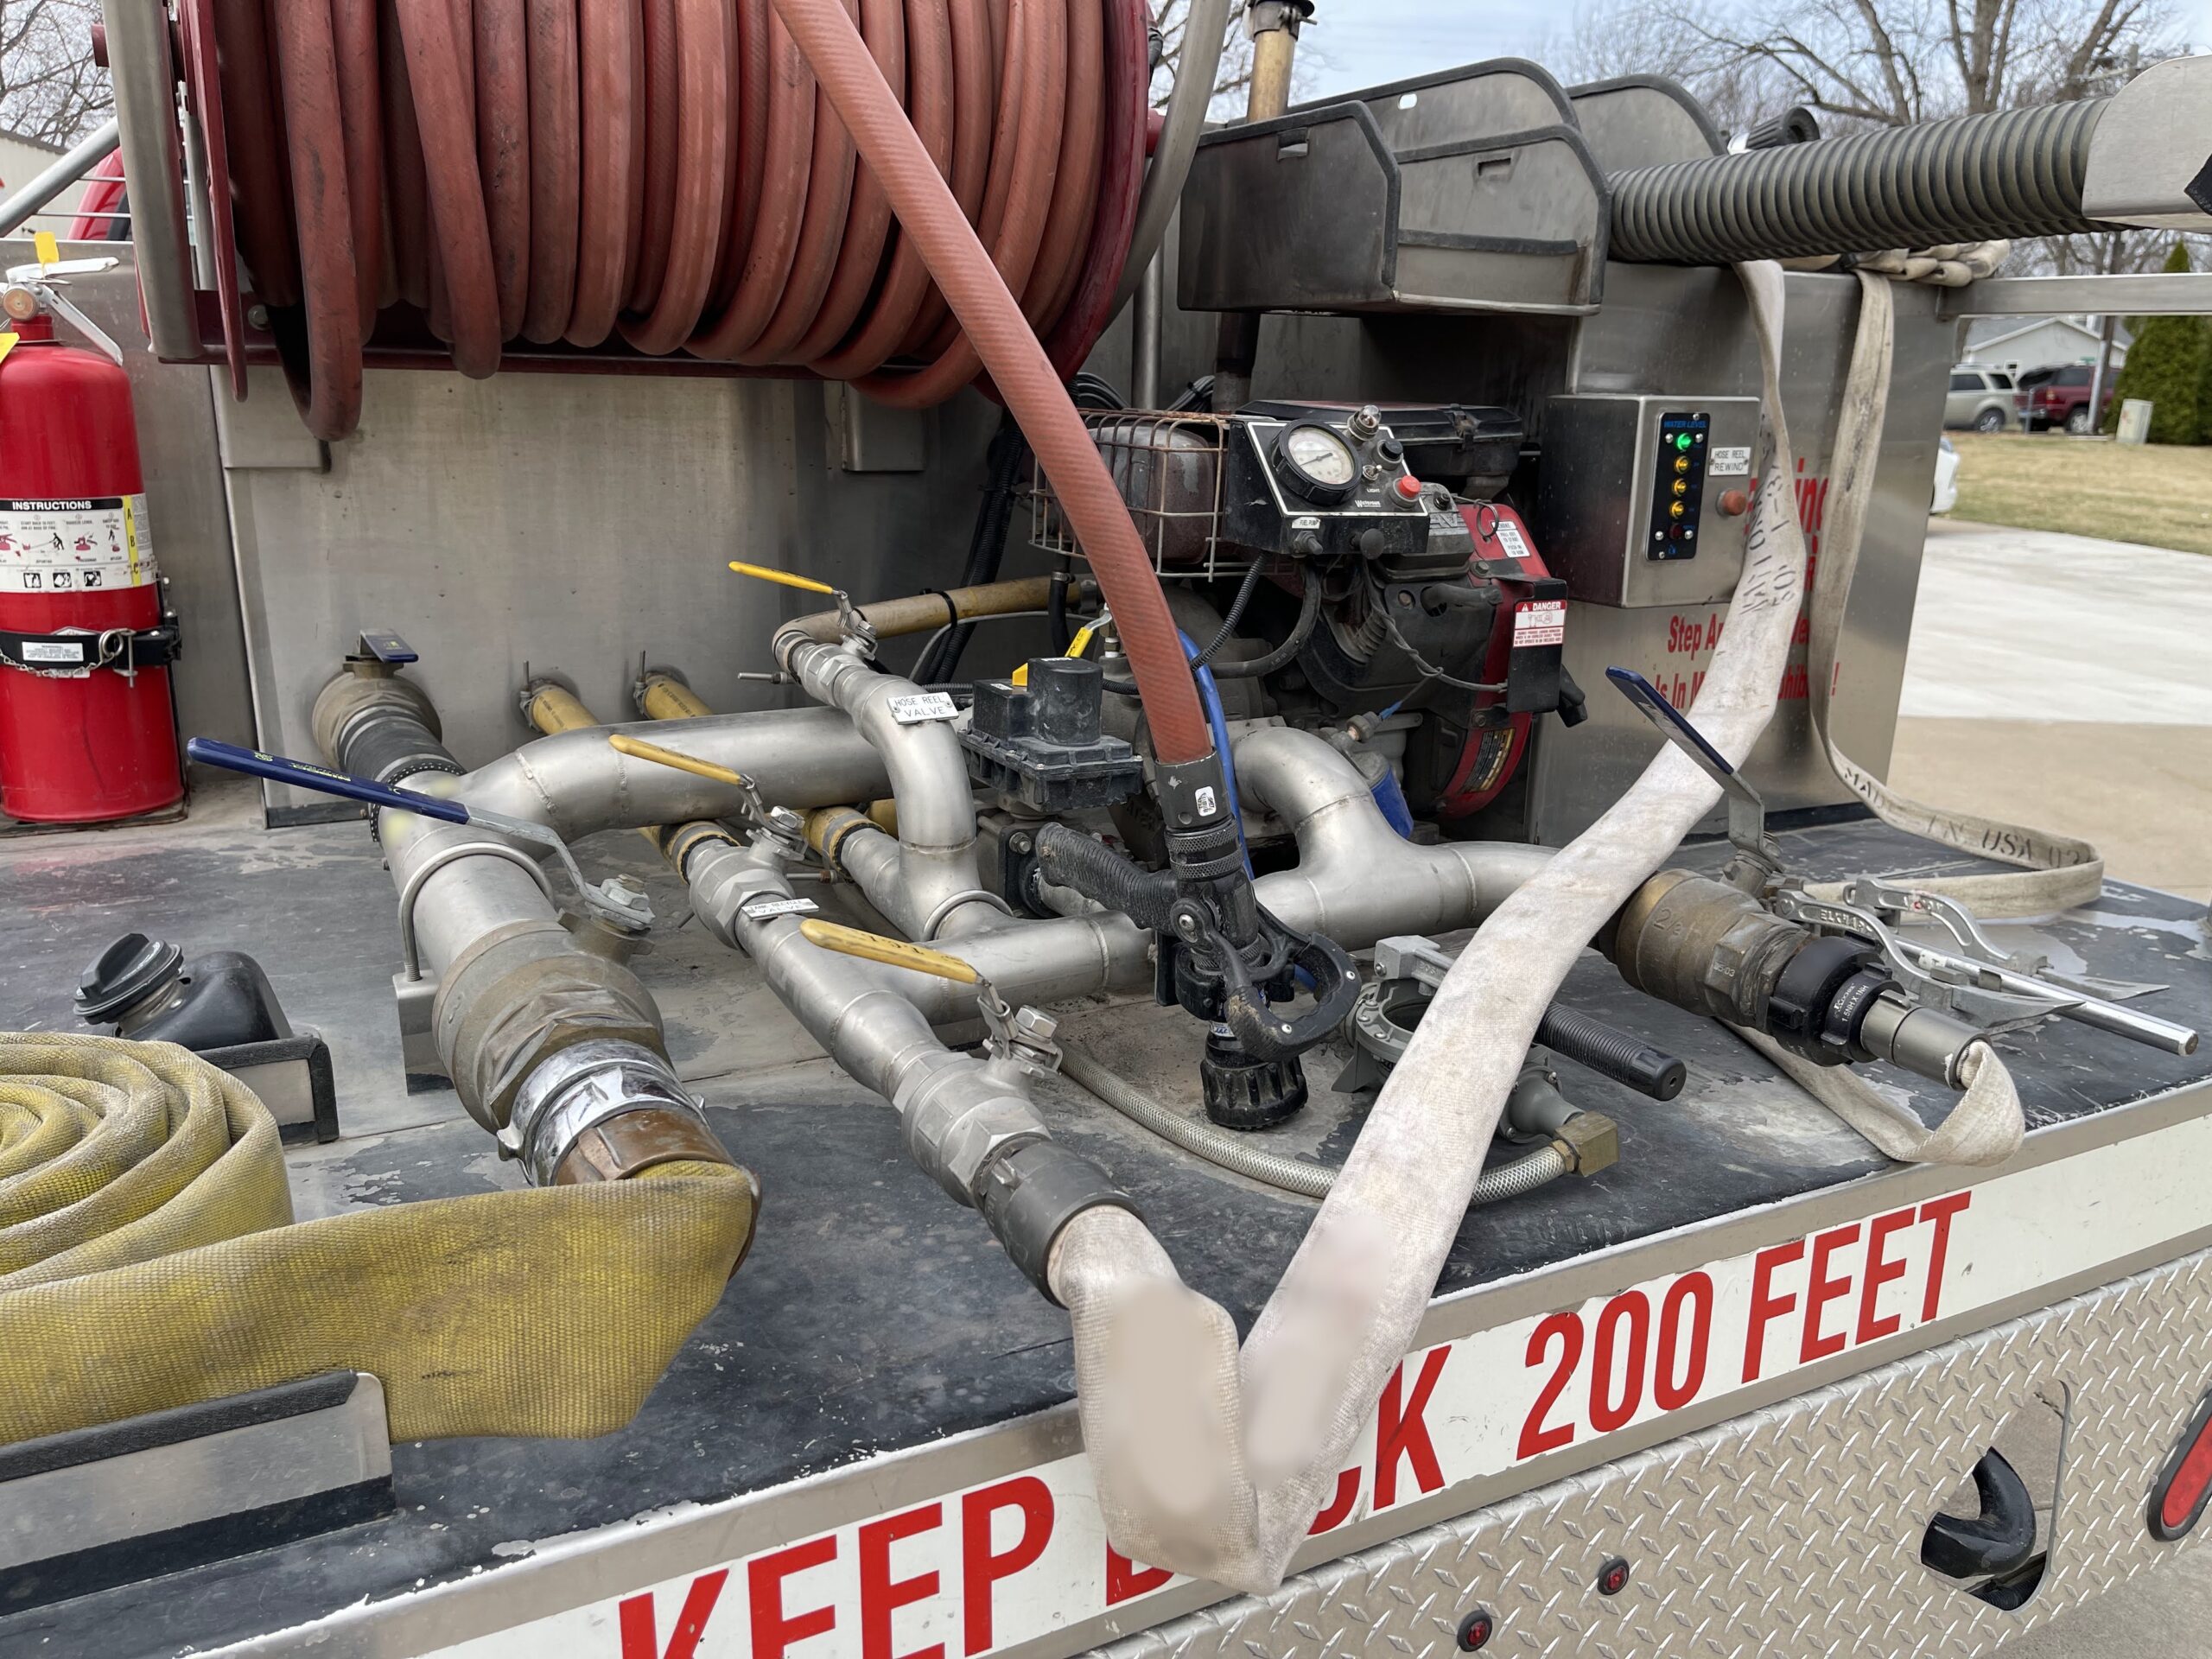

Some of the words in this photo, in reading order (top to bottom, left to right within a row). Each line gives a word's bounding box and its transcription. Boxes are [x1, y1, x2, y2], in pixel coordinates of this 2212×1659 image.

[1732, 449, 1745, 458] REEL
[1714, 462, 1744, 471] REWIND
[12, 500, 92, 511] INSTRUCTIONS
[1533, 601, 1561, 611] DANGER
[1668, 615, 1702, 661] Step
[1672, 673, 1686, 709] In
[894, 698, 916, 707] HOSE
[922, 696, 944, 704] REEL
[904, 707, 946, 717] VALVE
[1982, 828, 2032, 860] USA
[1516, 1270, 1714, 1461] 200
[1742, 1191, 1972, 1384] FEET
